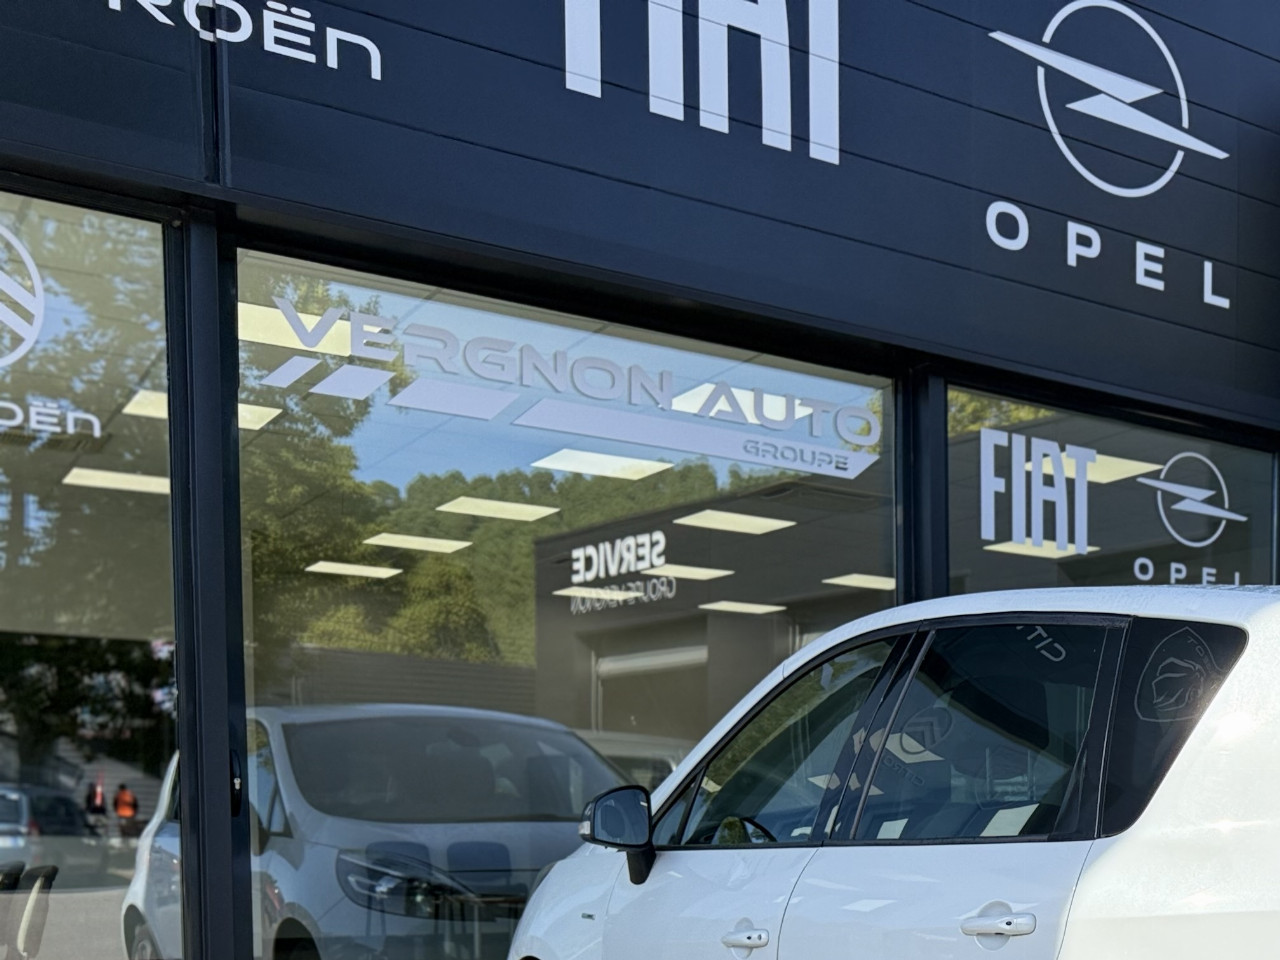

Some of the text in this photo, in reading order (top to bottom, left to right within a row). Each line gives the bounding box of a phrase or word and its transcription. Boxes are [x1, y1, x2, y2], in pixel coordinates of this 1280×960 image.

[986, 201, 1230, 309] OPEL
[272, 296, 881, 447] VERGNON AUTO
[743, 439, 850, 472] GROUPE
[980, 427, 1098, 556] FIAT
